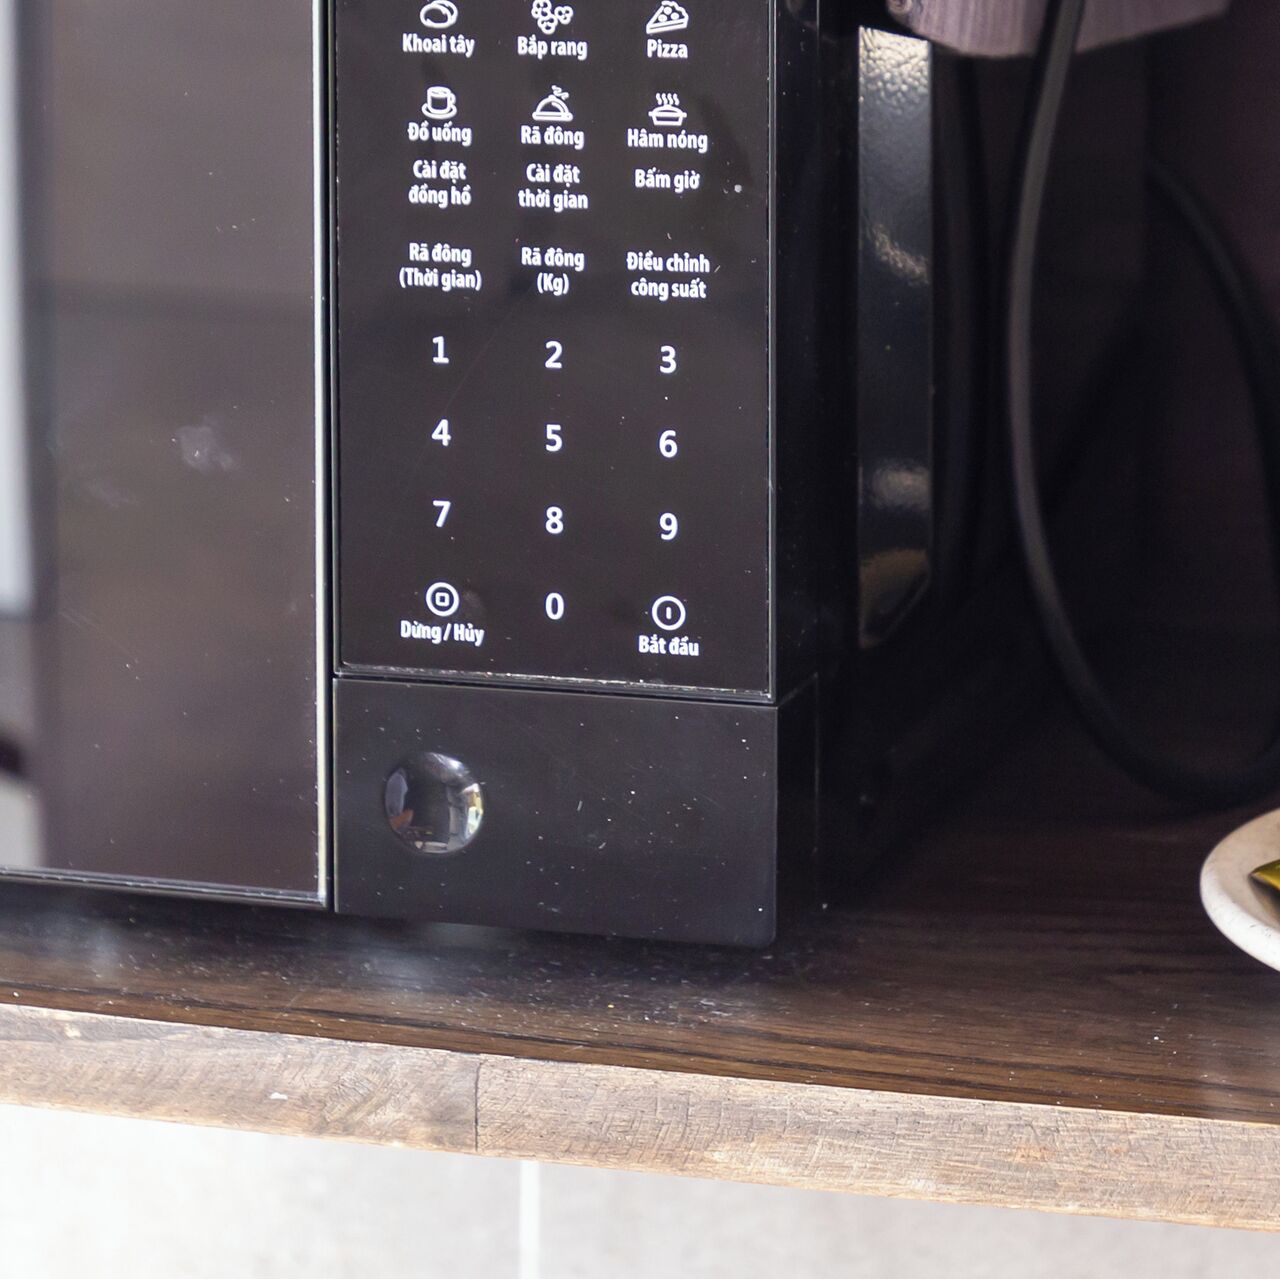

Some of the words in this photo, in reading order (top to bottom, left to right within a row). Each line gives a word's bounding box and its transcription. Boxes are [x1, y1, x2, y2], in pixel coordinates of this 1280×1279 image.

[402, 33, 447, 54] Khoai
[449, 34, 475, 58] tây
[517, 36, 548, 60] Bắp
[550, 40, 588, 61] rang
[646, 39, 689, 59] Pizza
[407, 120, 430, 142] Đồ
[432, 120, 473, 147] uống
[520, 125, 542, 145] Rã
[544, 125, 585, 150] đông
[627, 128, 664, 148] Hâm
[667, 129, 708, 153] nóng
[413, 160, 437, 179] Cài
[439, 160, 467, 185] đặt
[526, 163, 551, 182] Cài
[553, 163, 580, 187] đặt
[635, 167, 671, 189] Bấm
[674, 169, 700, 194] giờ
[408, 184, 449, 208] đồng
[450, 184, 472, 206] hồ
[518, 189, 551, 208] thời
[553, 190, 588, 213] gian
[409, 242, 430, 262] Rã
[432, 243, 472, 267] đông
[521, 247, 542, 266] Rã
[544, 247, 585, 271] đông
[626, 250, 663, 272] Điều
[665, 251, 710, 273] chỉnh
[399, 267, 440, 289] (Thời
[441, 269, 482, 292] gian)
[536, 272, 570, 297] (Kg)
[631, 278, 669, 301] công
[671, 278, 707, 299] suất
[432, 336, 450, 364] 1
[544, 341, 563, 369] 2
[659, 346, 677, 374] 3
[431, 419, 452, 447] 4
[545, 424, 563, 452] 5
[658, 430, 678, 458] 6
[432, 500, 452, 528] 7
[545, 506, 564, 535] 8
[659, 513, 679, 541] 9
[545, 592, 565, 620] 0
[400, 620, 442, 645] Dừng
[453, 623, 485, 647] Hủy
[638, 634, 666, 655] Bắt
[669, 636, 700, 657] đầu
